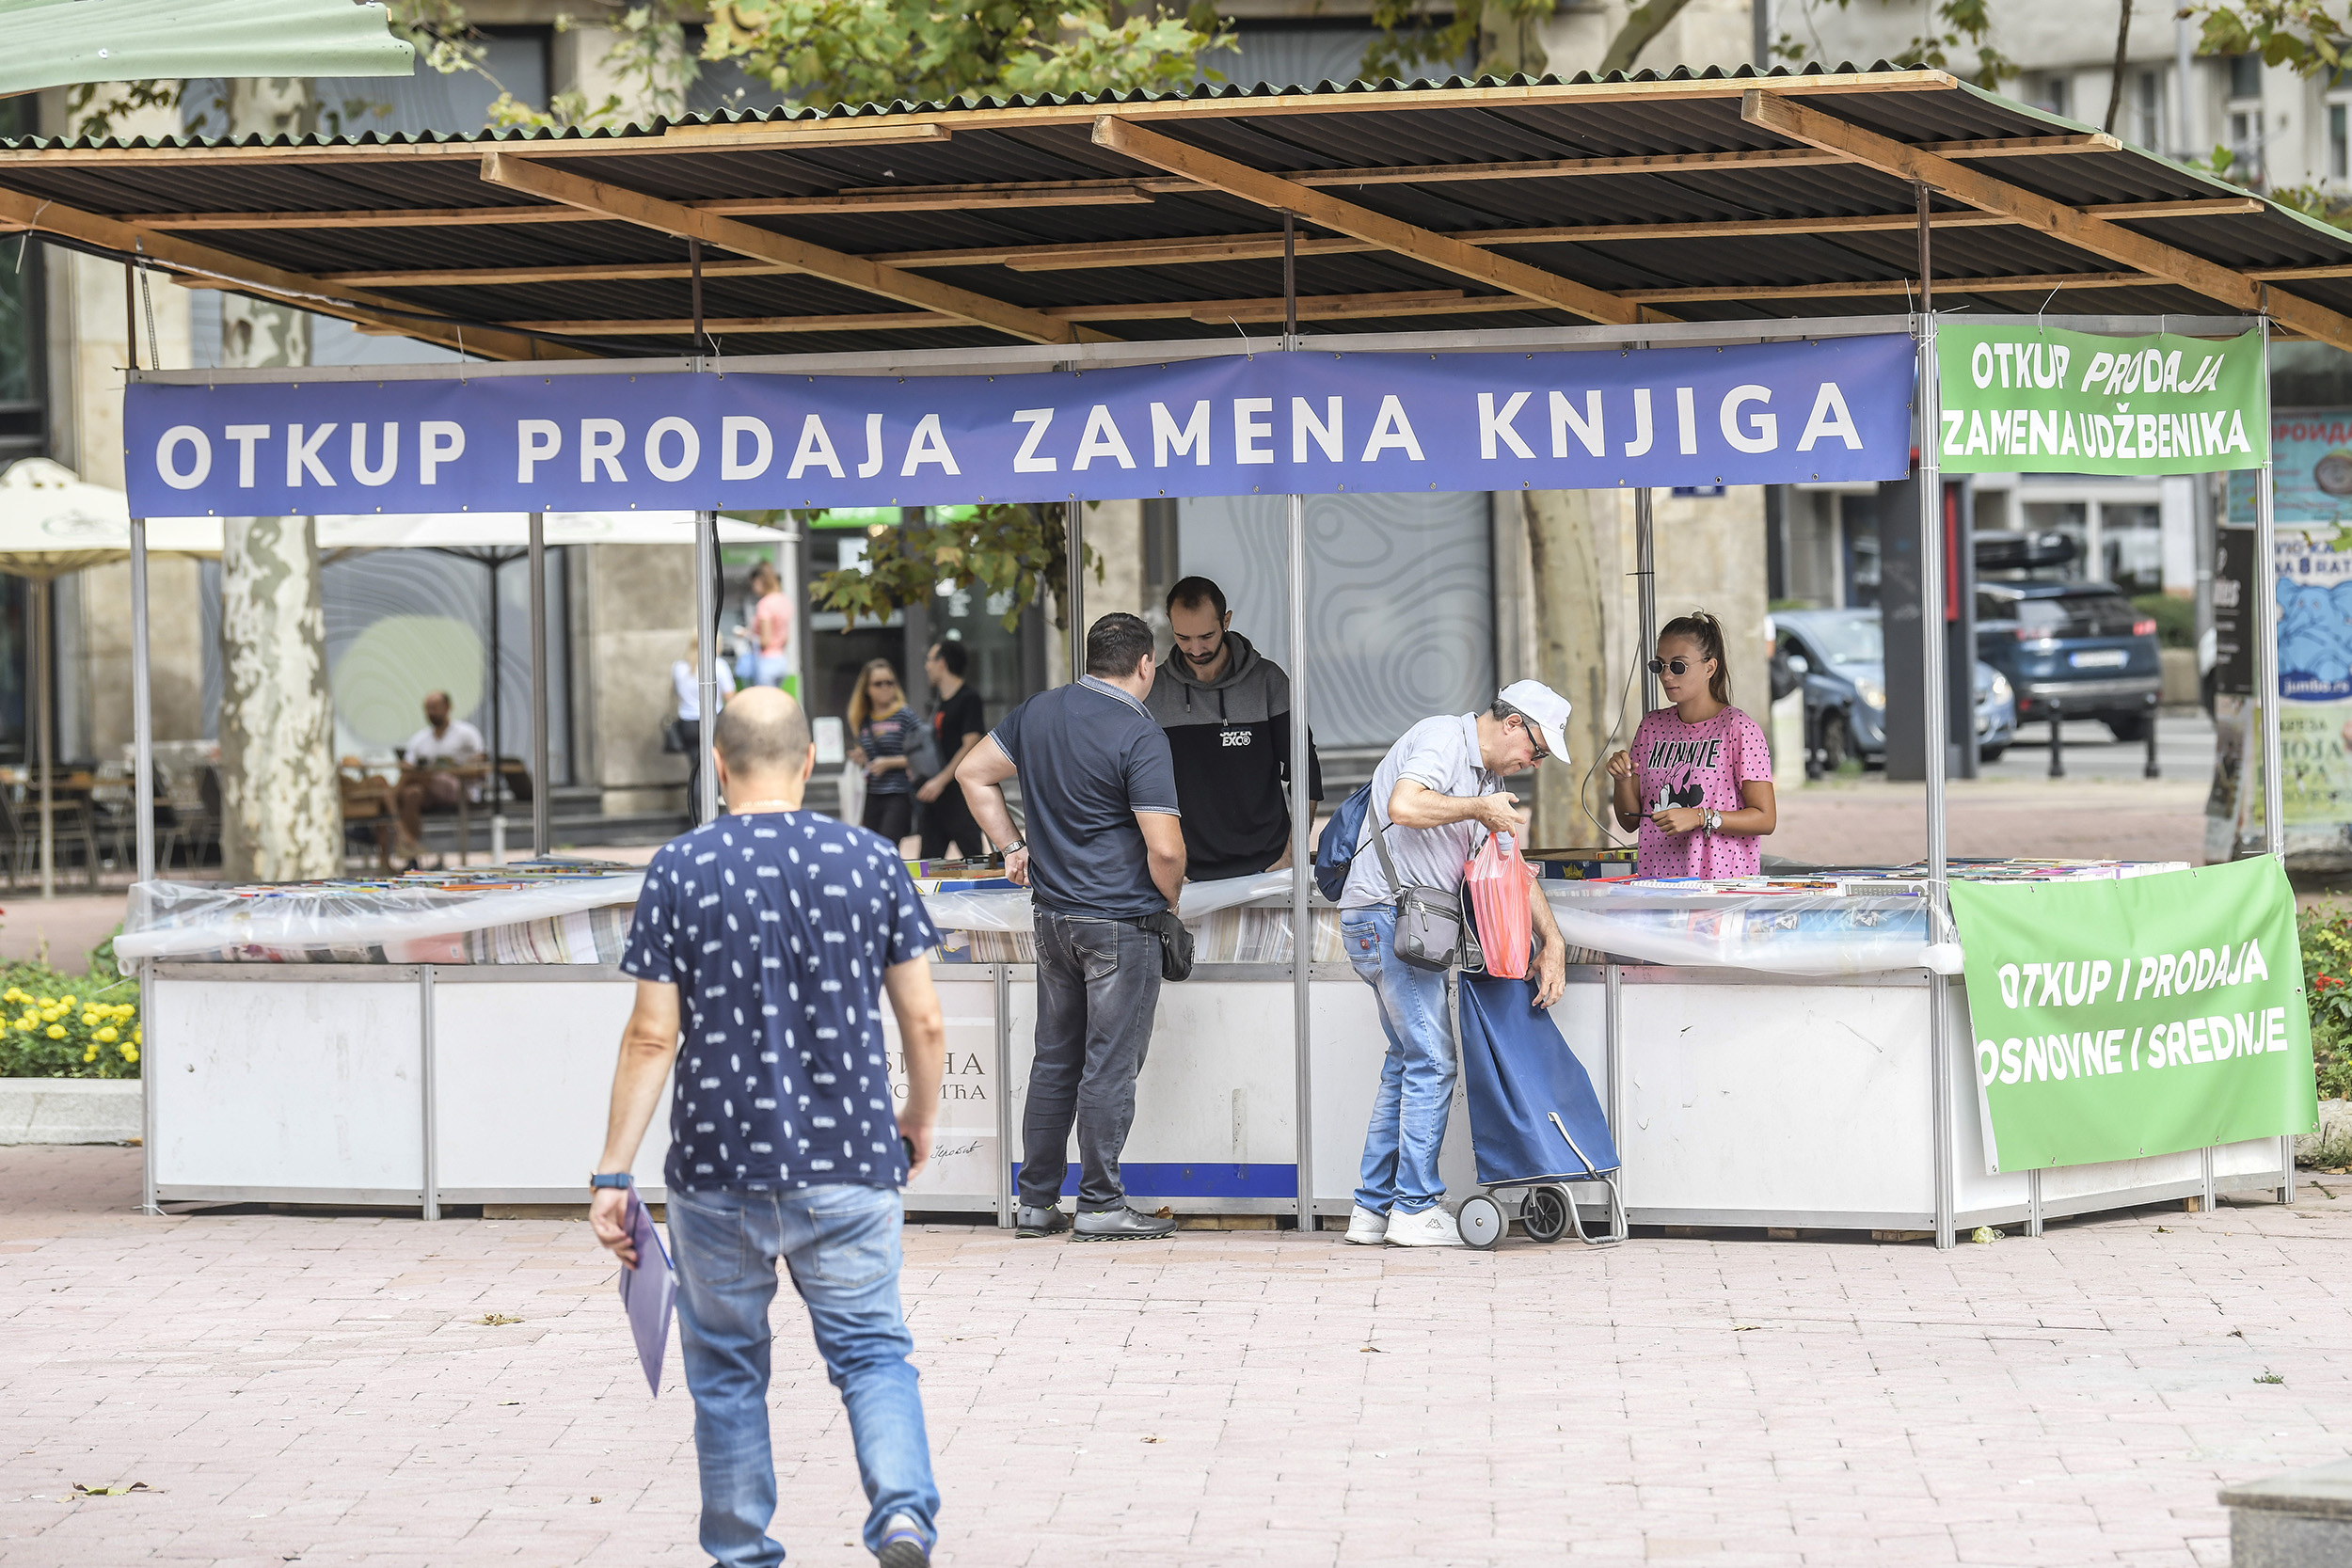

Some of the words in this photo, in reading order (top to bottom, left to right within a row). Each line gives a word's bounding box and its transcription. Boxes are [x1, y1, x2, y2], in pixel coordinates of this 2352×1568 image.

[1972, 342, 2071, 389] OTKUP
[2081, 348, 2225, 395] PRODAJA
[155, 421, 466, 490] OTKUP
[517, 413, 961, 483] PRODAJA
[1011, 395, 1426, 473] ZAMENA
[1477, 382, 1864, 461] KNJIGA
[1942, 409, 2080, 456] ZAMENA
[2079, 403, 2252, 458] UDŽBENIKA
[2283, 677, 2350, 696] jumbo.rs
[1647, 738, 1721, 769] MINNIE
[2116, 958, 2131, 1003] I
[2134, 938, 2269, 1001] PRODAJA
[1977, 1029, 2124, 1086] OSNOVNE
[2130, 1027, 2143, 1071] I
[2147, 1006, 2288, 1069] SREDNJE
